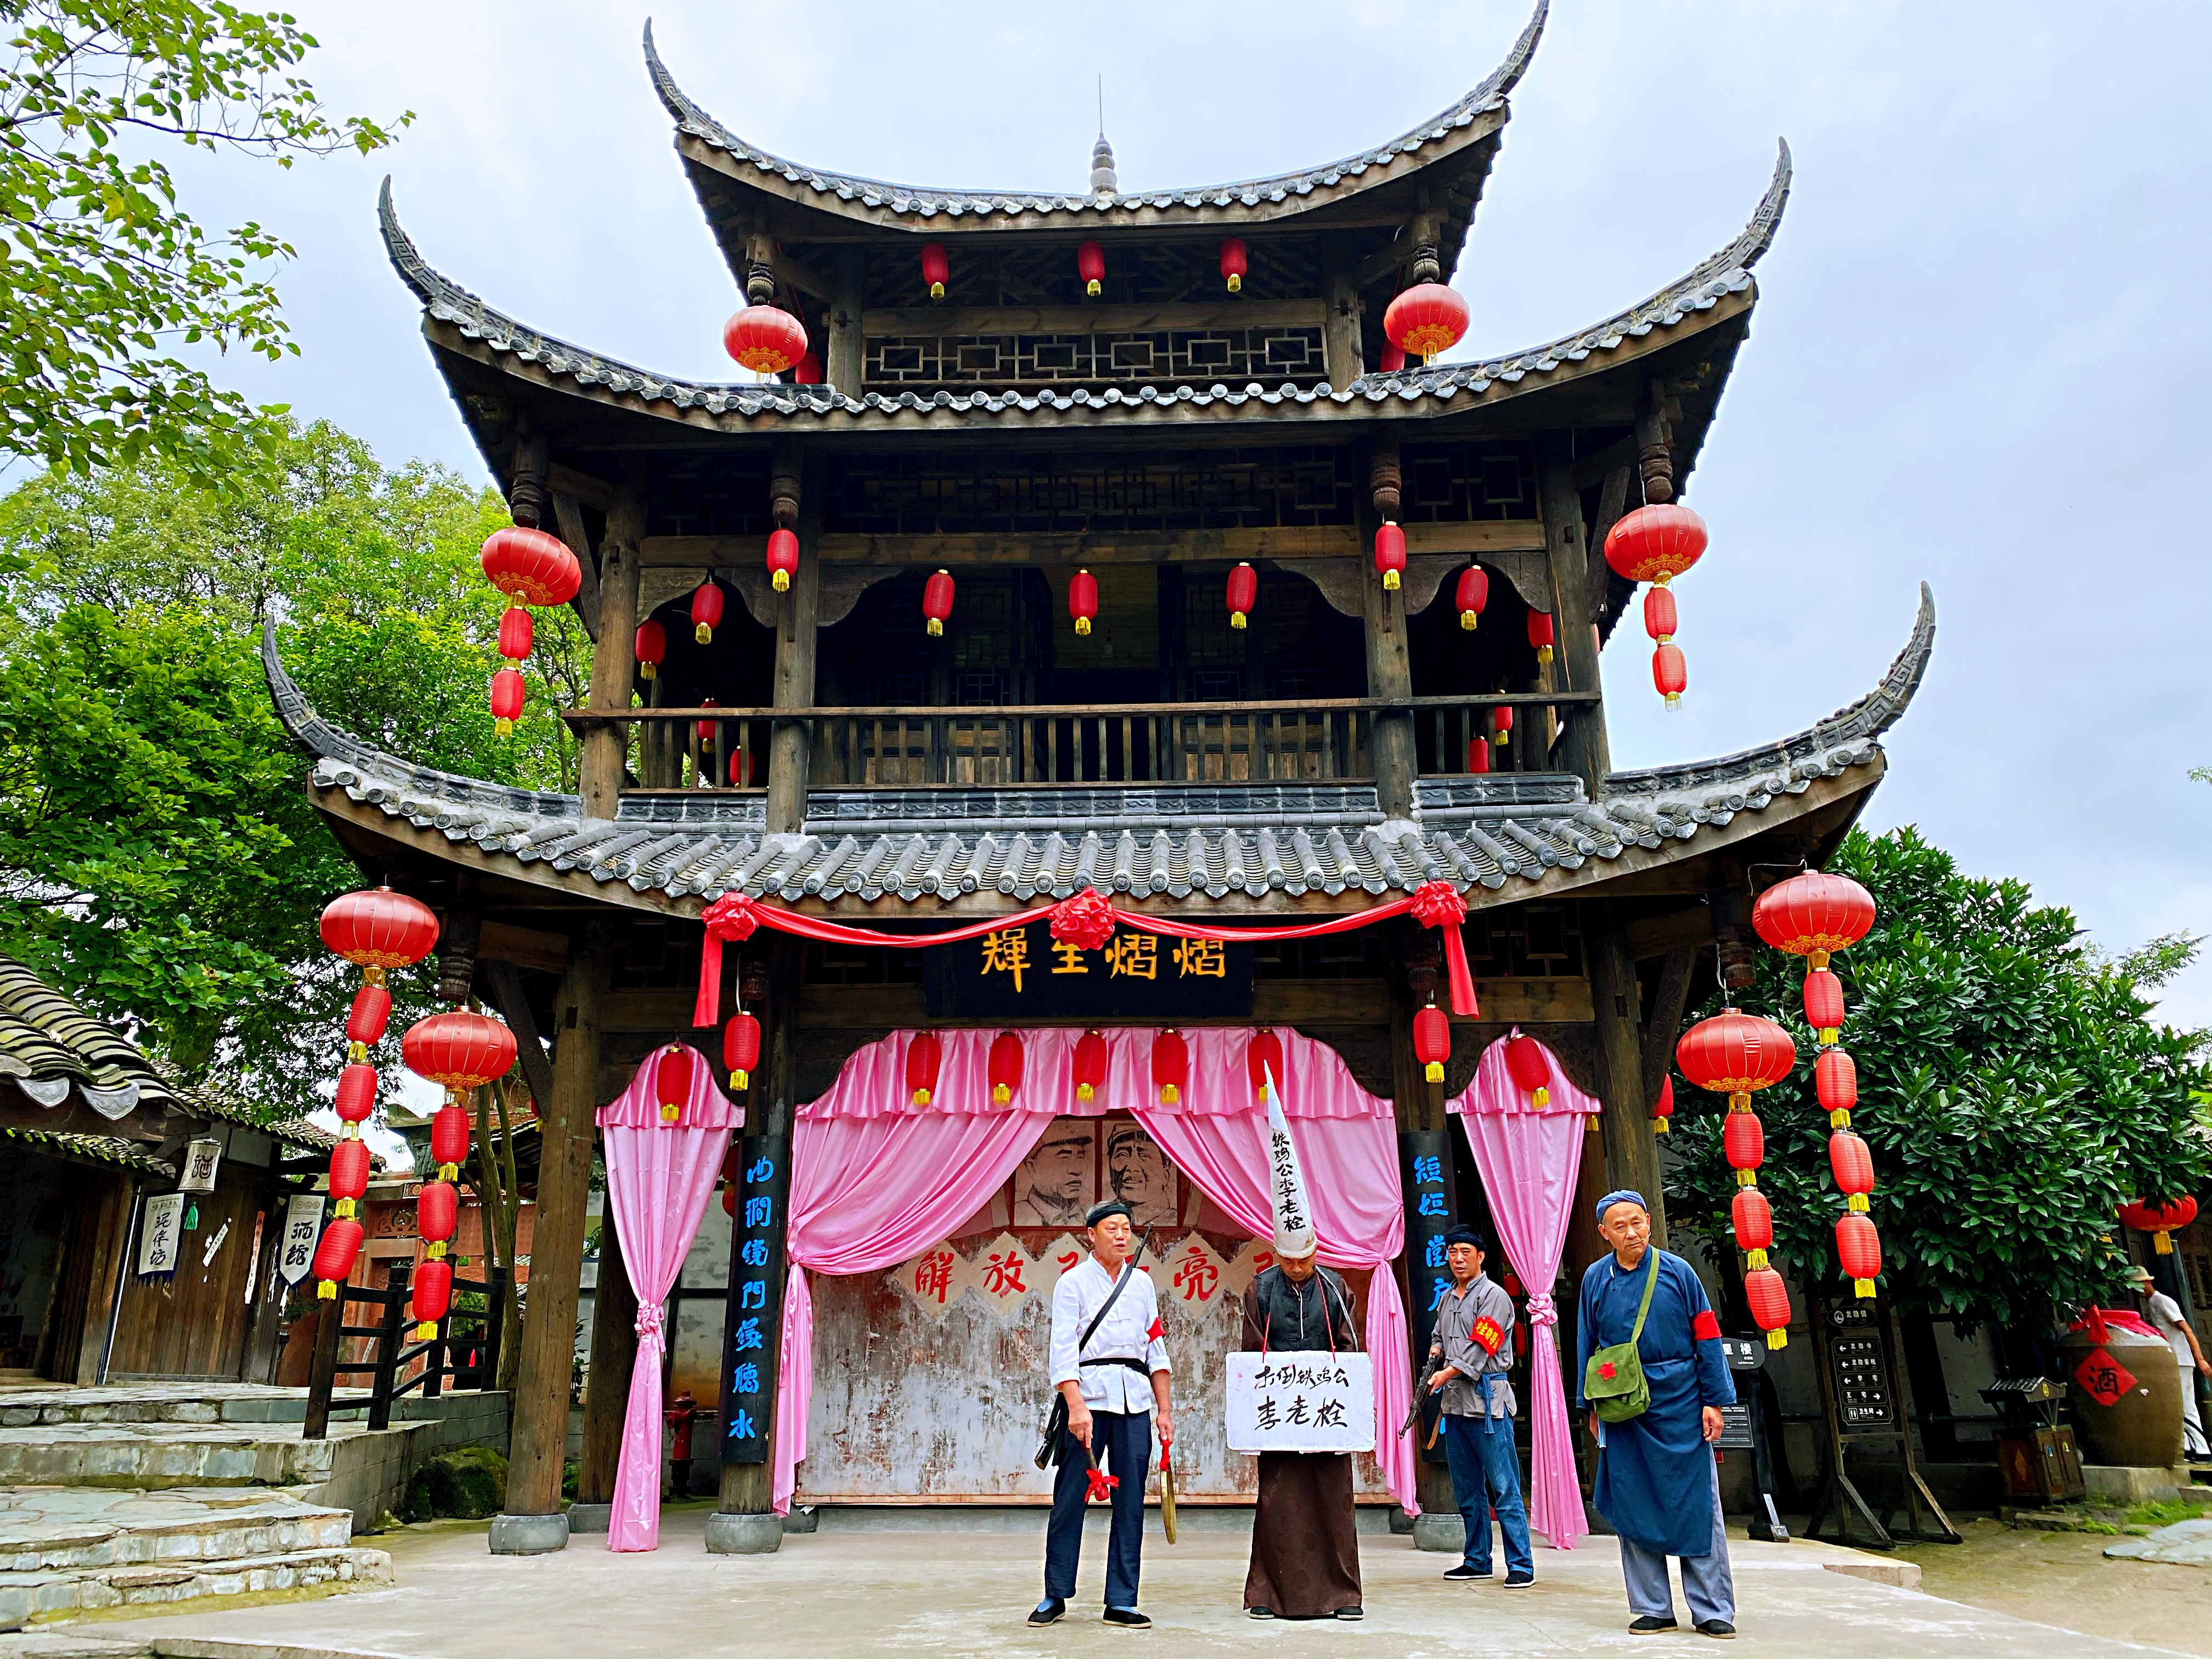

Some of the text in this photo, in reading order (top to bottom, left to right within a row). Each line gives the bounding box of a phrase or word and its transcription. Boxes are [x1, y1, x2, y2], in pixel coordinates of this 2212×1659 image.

[191, 1154, 214, 1179] 酒
[1254, 1364, 1349, 1389] 打倒铁鸡公
[2089, 1367, 2120, 1396] 酒
[1254, 1395, 1348, 1431] 李老栓
